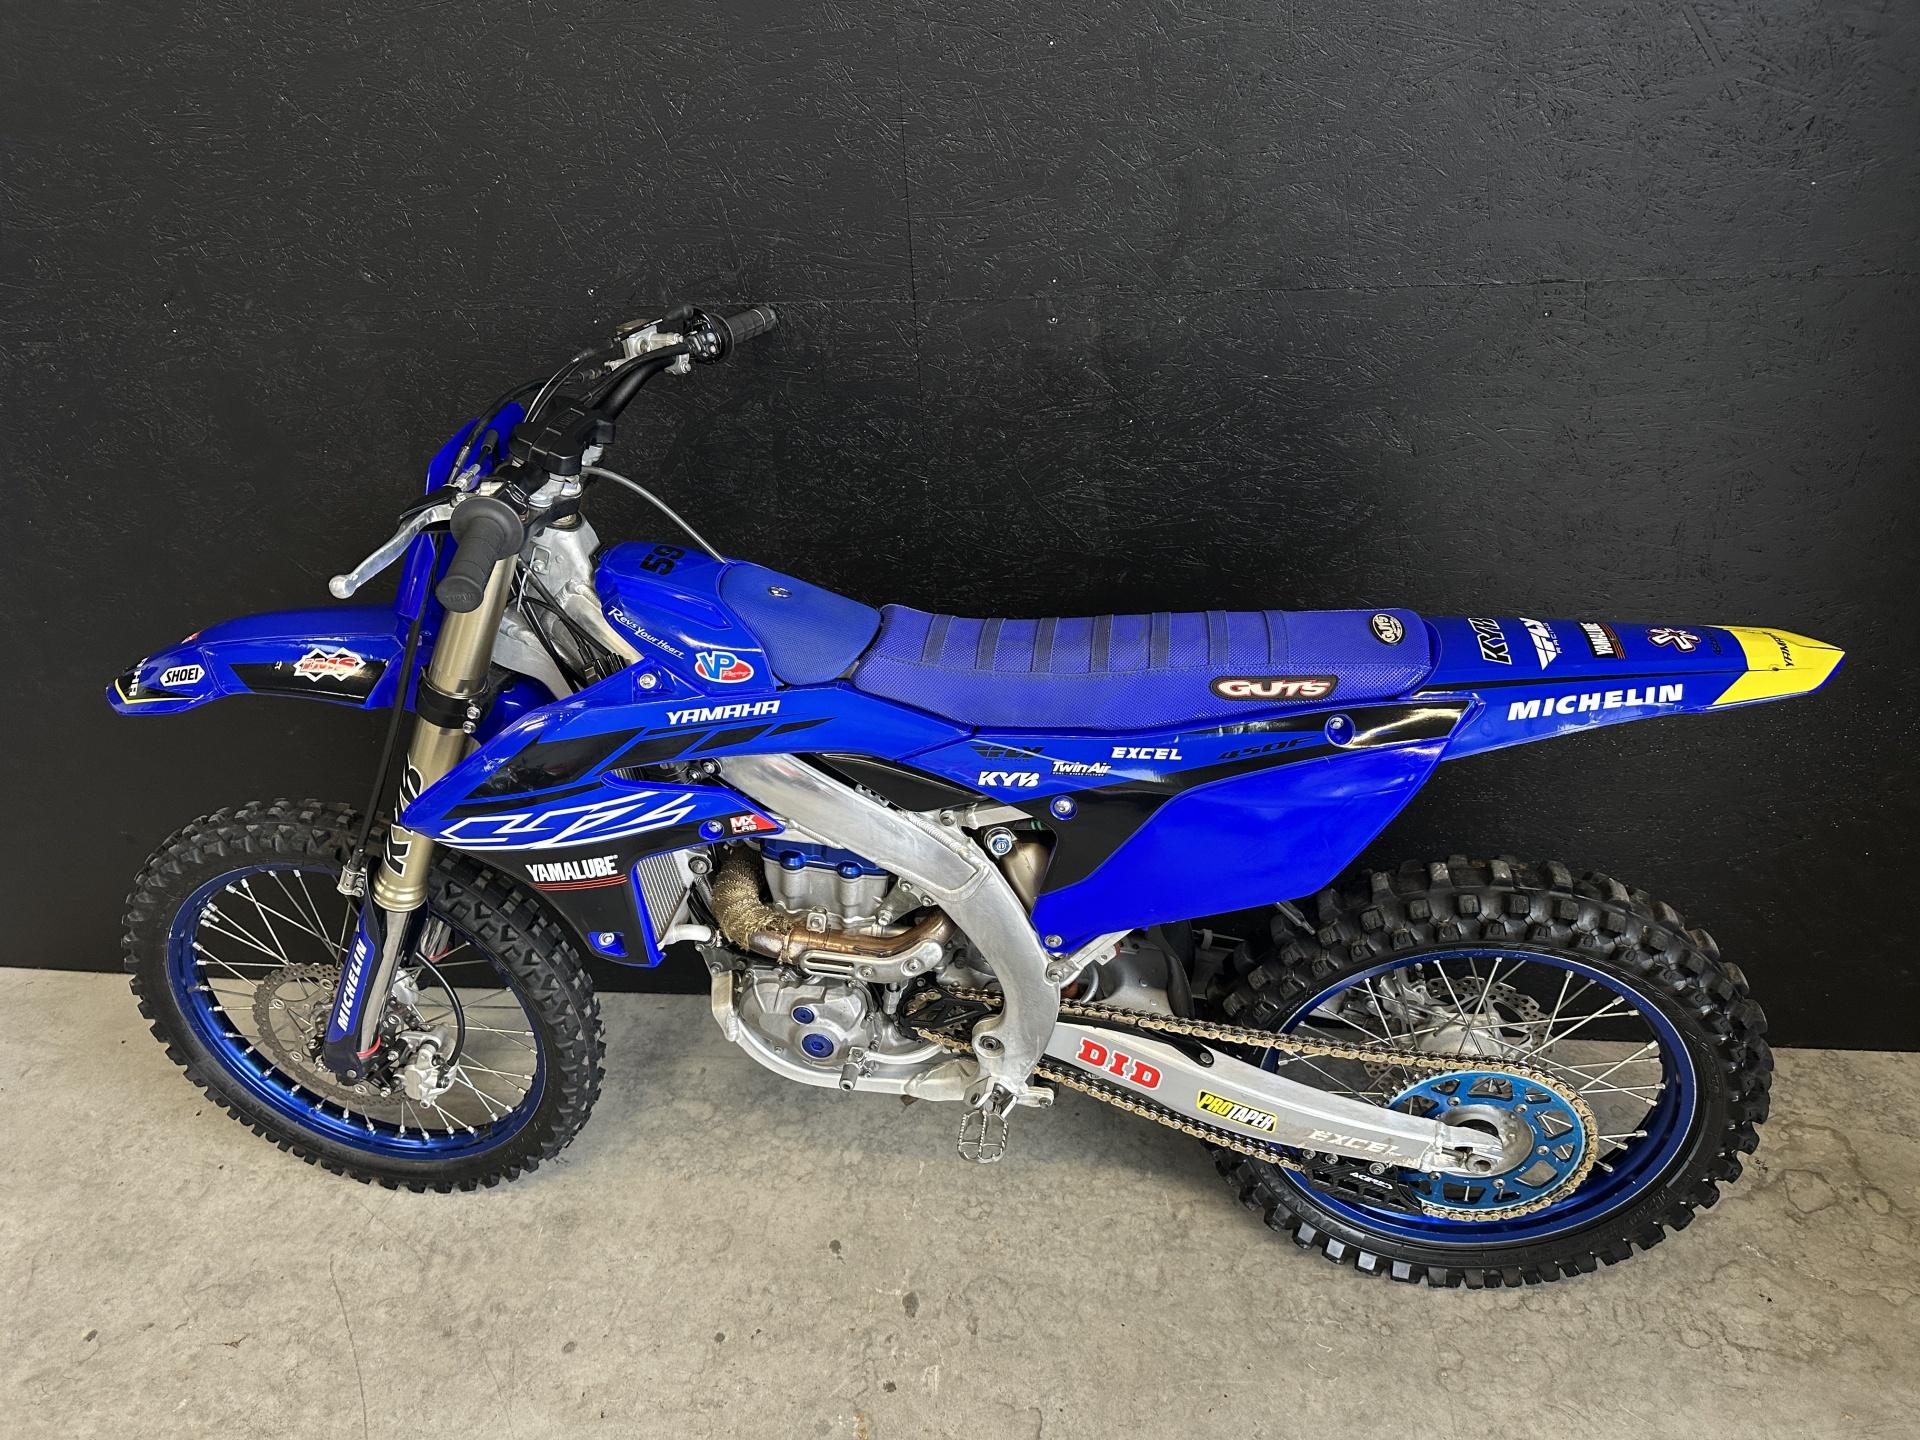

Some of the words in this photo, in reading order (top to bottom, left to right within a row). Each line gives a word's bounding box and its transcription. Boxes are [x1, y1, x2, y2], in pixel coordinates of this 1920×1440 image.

[640, 545, 685, 575] 59
[165, 668, 199, 684] SHOEI
[696, 651, 737, 680] VP
[1218, 680, 1331, 697] GUTS
[665, 700, 781, 725] YAMAHA
[1507, 684, 1683, 721] MICHELIN
[1111, 746, 1183, 761] EXCEL
[978, 771, 1040, 787] KYB
[730, 814, 755, 828] MX
[525, 854, 616, 883] YAMALUBE
[337, 938, 367, 1031] MICHELIN
[1308, 1128, 1402, 1157] EXCEL
